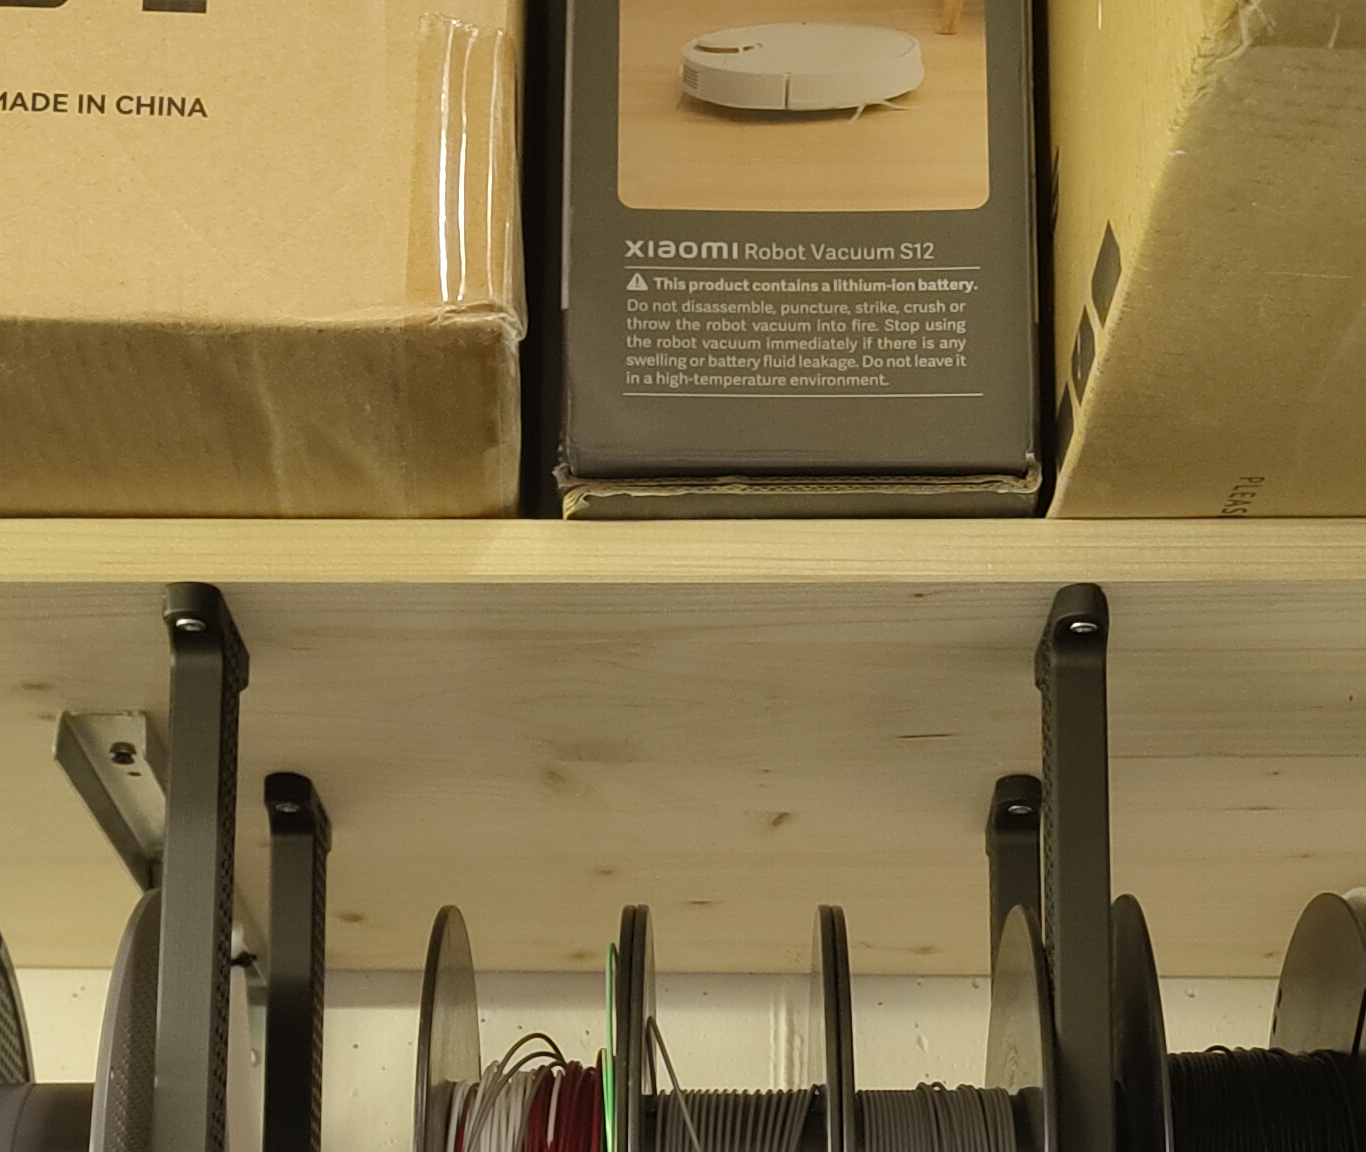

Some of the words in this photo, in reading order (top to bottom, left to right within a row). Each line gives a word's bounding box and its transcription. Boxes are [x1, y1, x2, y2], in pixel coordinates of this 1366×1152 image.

[77, 94, 107, 114] IN
[116, 95, 208, 118] CHINA
[745, 243, 807, 261] Robot
[810, 243, 895, 261] Vacuum
[899, 242, 935, 260] S12
[653, 276, 686, 291] This
[688, 278, 750, 294] product
[752, 279, 819, 292] contains
[821, 282, 831, 292] a
[833, 278, 916, 292] lithium-ion
[918, 278, 979, 294] battery.
[626, 299, 649, 312] Do
[652, 300, 678, 313] not
[681, 300, 777, 316] disassemble,
[780, 302, 852, 317] puncture,
[855, 301, 900, 315] strike,
[903, 300, 946, 314] crush
[949, 302, 966, 313] or
[626, 317, 671, 331] throw
[676, 317, 701, 331] the
[706, 318, 747, 332] robot
[752, 320, 811, 332] vacuum
[816, 318, 847, 333] into
[851, 318, 880, 333] fire.
[884, 318, 920, 334] Stop
[925, 317, 967, 334] using
[626, 334, 652, 348] the
[656, 335, 698, 349] robot
[701, 338, 761, 350] vacuum
[766, 336, 858, 353] immediately
[862, 336, 874, 350] if
[877, 336, 918, 350] there
[922, 336, 935, 350] is
[939, 338, 967, 353] any
[626, 353, 687, 370] swelling
[689, 357, 706, 368] or
[708, 354, 761, 371] battery
[763, 354, 797, 368] fluid
[798, 354, 860, 372] leakage.
[862, 355, 884, 368] Do
[886, 355, 913, 368] not
[914, 354, 953, 368] leave
[956, 353, 968, 368] it
[626, 371, 640, 385] in
[643, 373, 653, 385] a
[656, 371, 786, 389] high-temperature
[789, 373, 891, 387] environment.
